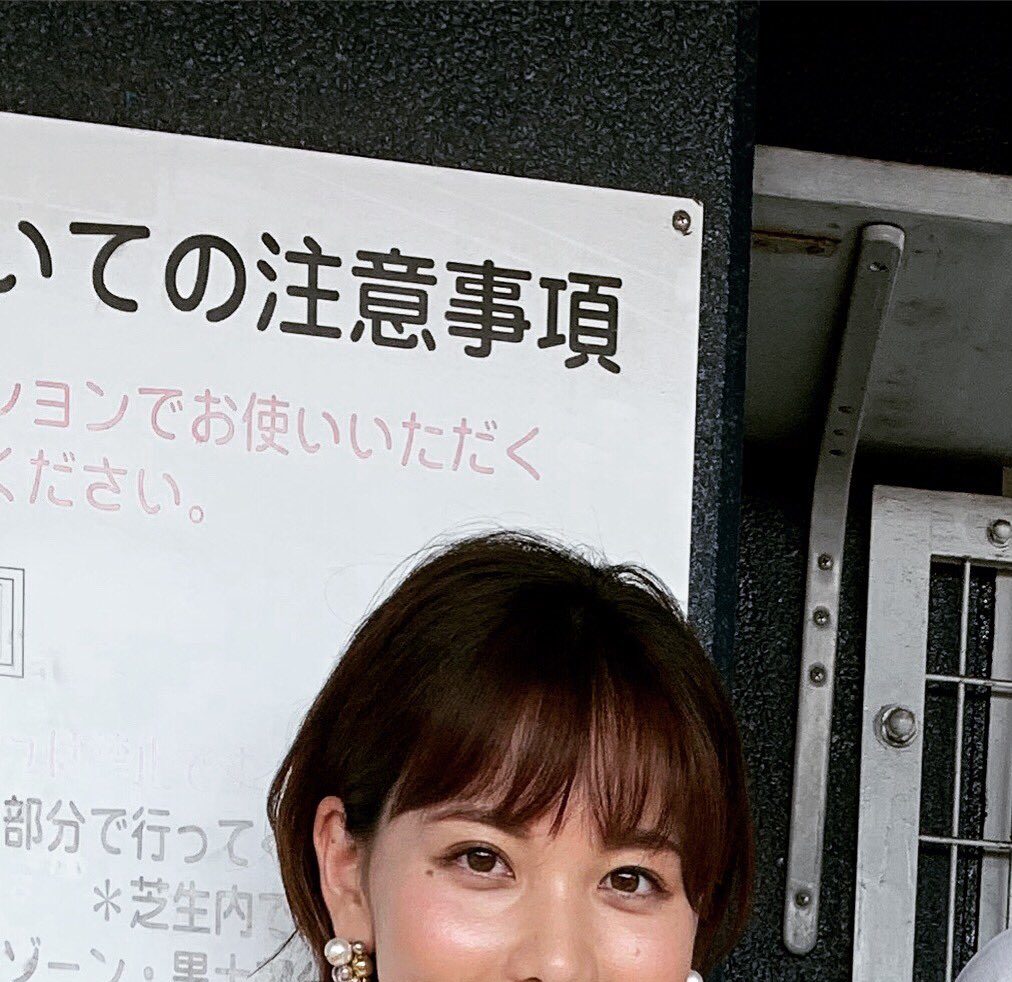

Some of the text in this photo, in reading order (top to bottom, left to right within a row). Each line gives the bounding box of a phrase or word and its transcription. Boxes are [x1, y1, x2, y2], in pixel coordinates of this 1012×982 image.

[3, 794, 276, 867] 部分で行って
